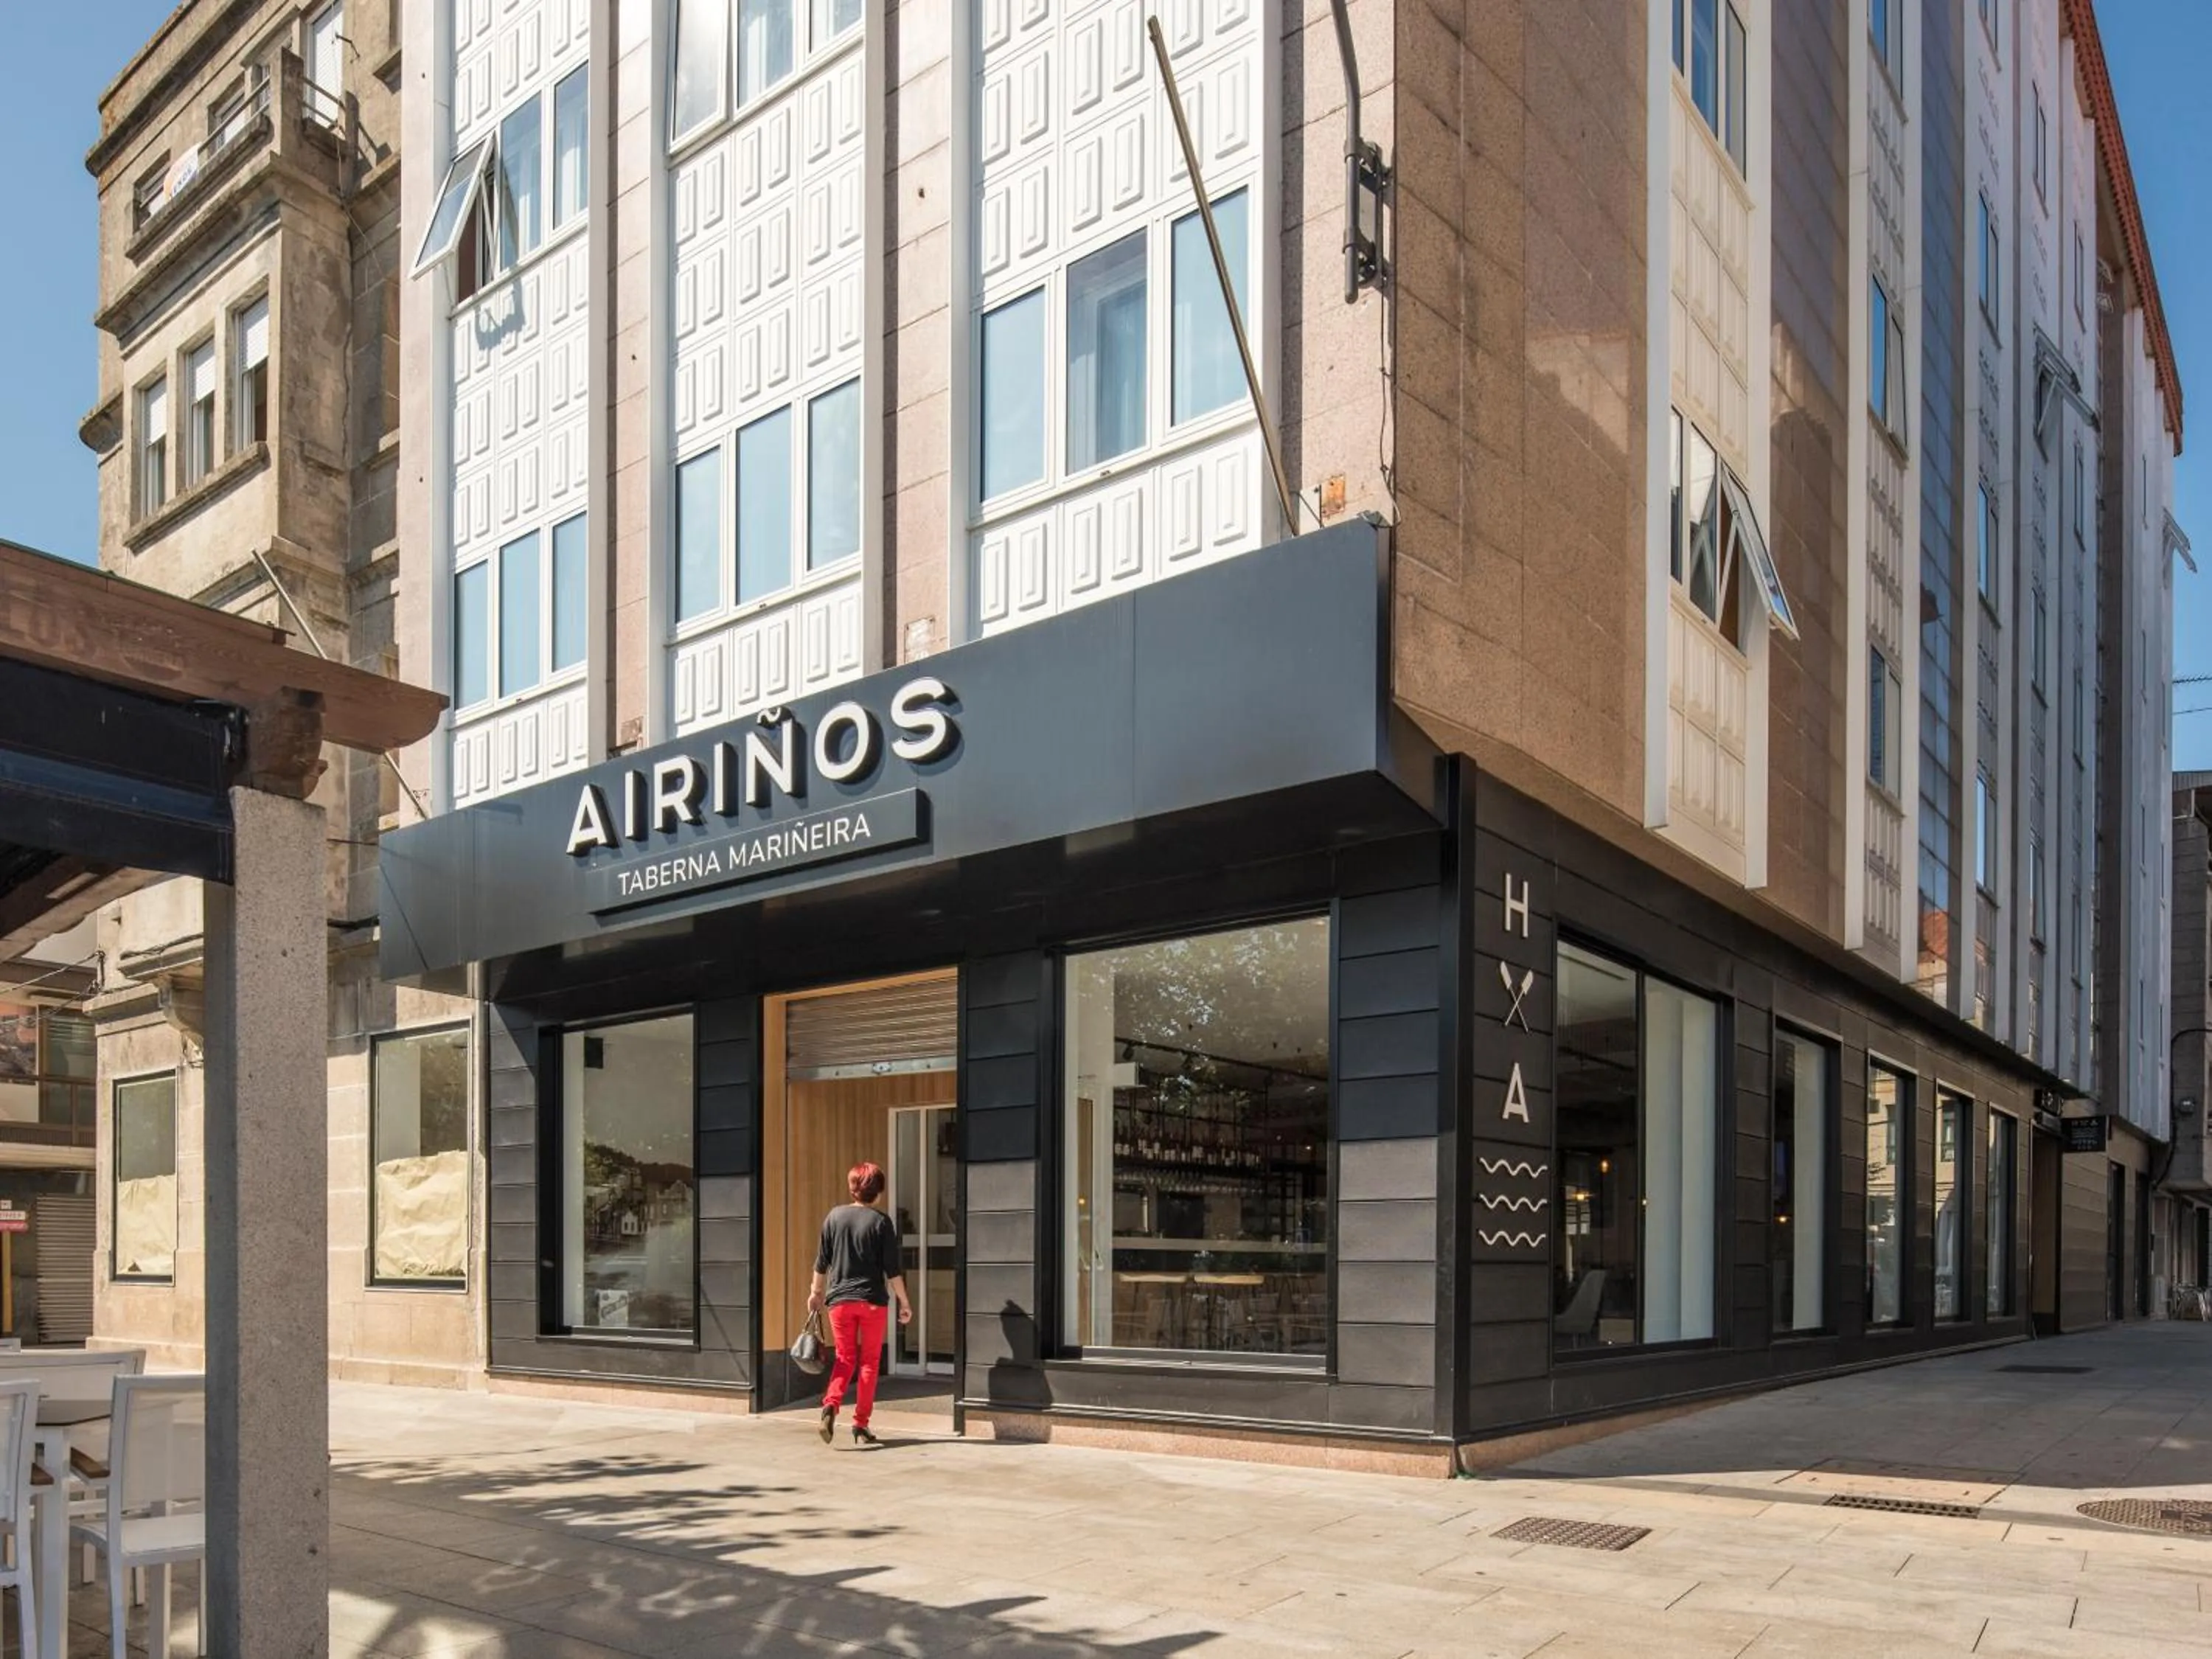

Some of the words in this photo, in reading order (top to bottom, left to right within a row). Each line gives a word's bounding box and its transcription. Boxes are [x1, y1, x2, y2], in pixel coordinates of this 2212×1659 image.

[566, 675, 949, 855] AIRIÑOS
[618, 851, 721, 896] TABERNA
[728, 813, 872, 870] MARIÑEIRA
